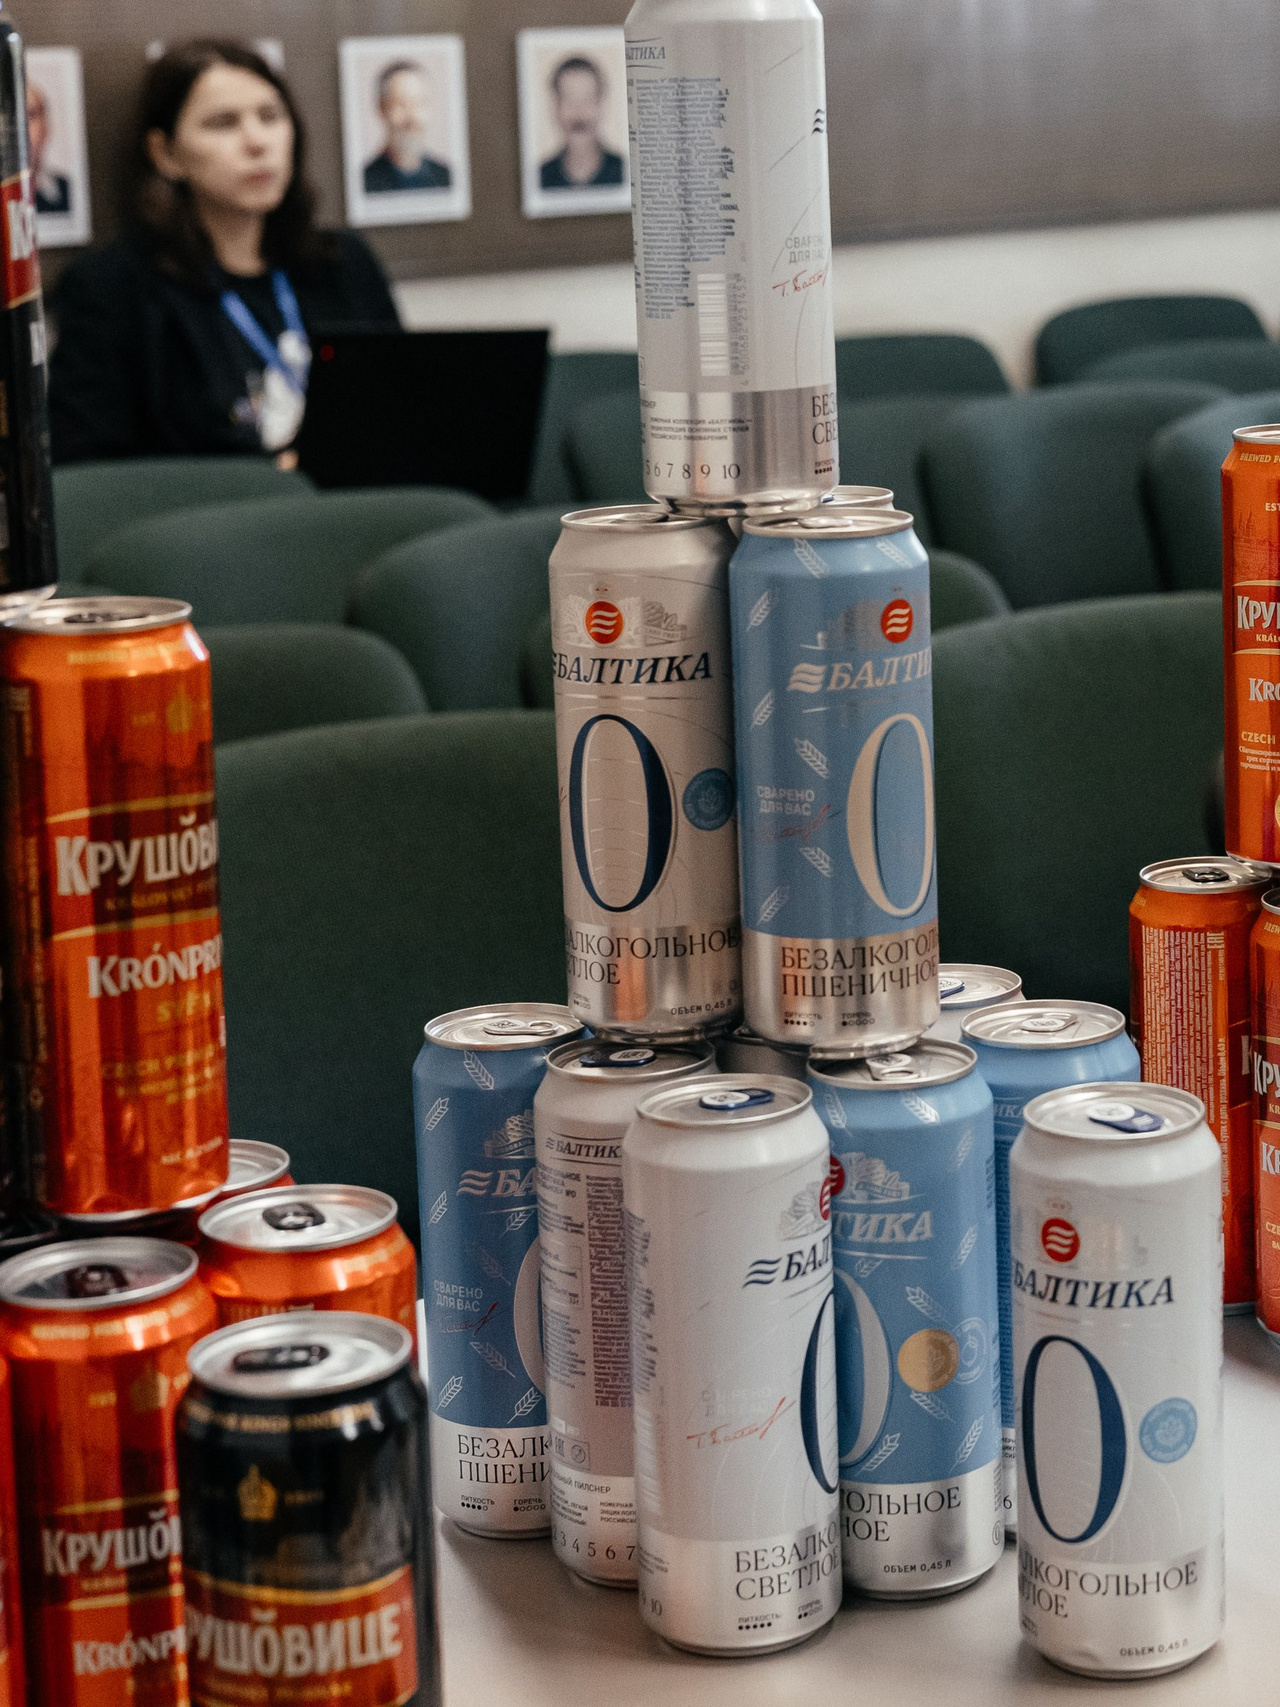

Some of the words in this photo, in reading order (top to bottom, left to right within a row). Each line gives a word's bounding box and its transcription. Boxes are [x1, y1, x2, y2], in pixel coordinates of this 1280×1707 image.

[1239, 452, 1271, 463] BREWED
[654, 461, 660, 477] 6
[667, 463, 674, 478] 7
[682, 464, 691, 479] 8
[701, 464, 711, 479] 9
[723, 464, 741, 479] 10
[557, 652, 712, 684] БАЛТИКА
[1241, 730, 1276, 745] CZECH
[782, 953, 937, 998] ПШЕНИЧНОЕ
[671, 1004, 703, 1016] ОБЪЕМ
[1014, 1260, 1175, 1310] БАЛТИКА
[456, 1298, 481, 1312] ВАС
[575, 1481, 611, 1494] ПИЛСНЕР
[1002, 1495, 1013, 1510] 6
[588, 1542, 596, 1557] 5
[606, 1545, 616, 1559] 6
[626, 1546, 636, 1560] 7
[884, 1564, 917, 1573] ОБЪЕМ
[920, 1561, 943, 1572] 0,45
[735, 1549, 840, 1601] СВЕТЛОЕ
